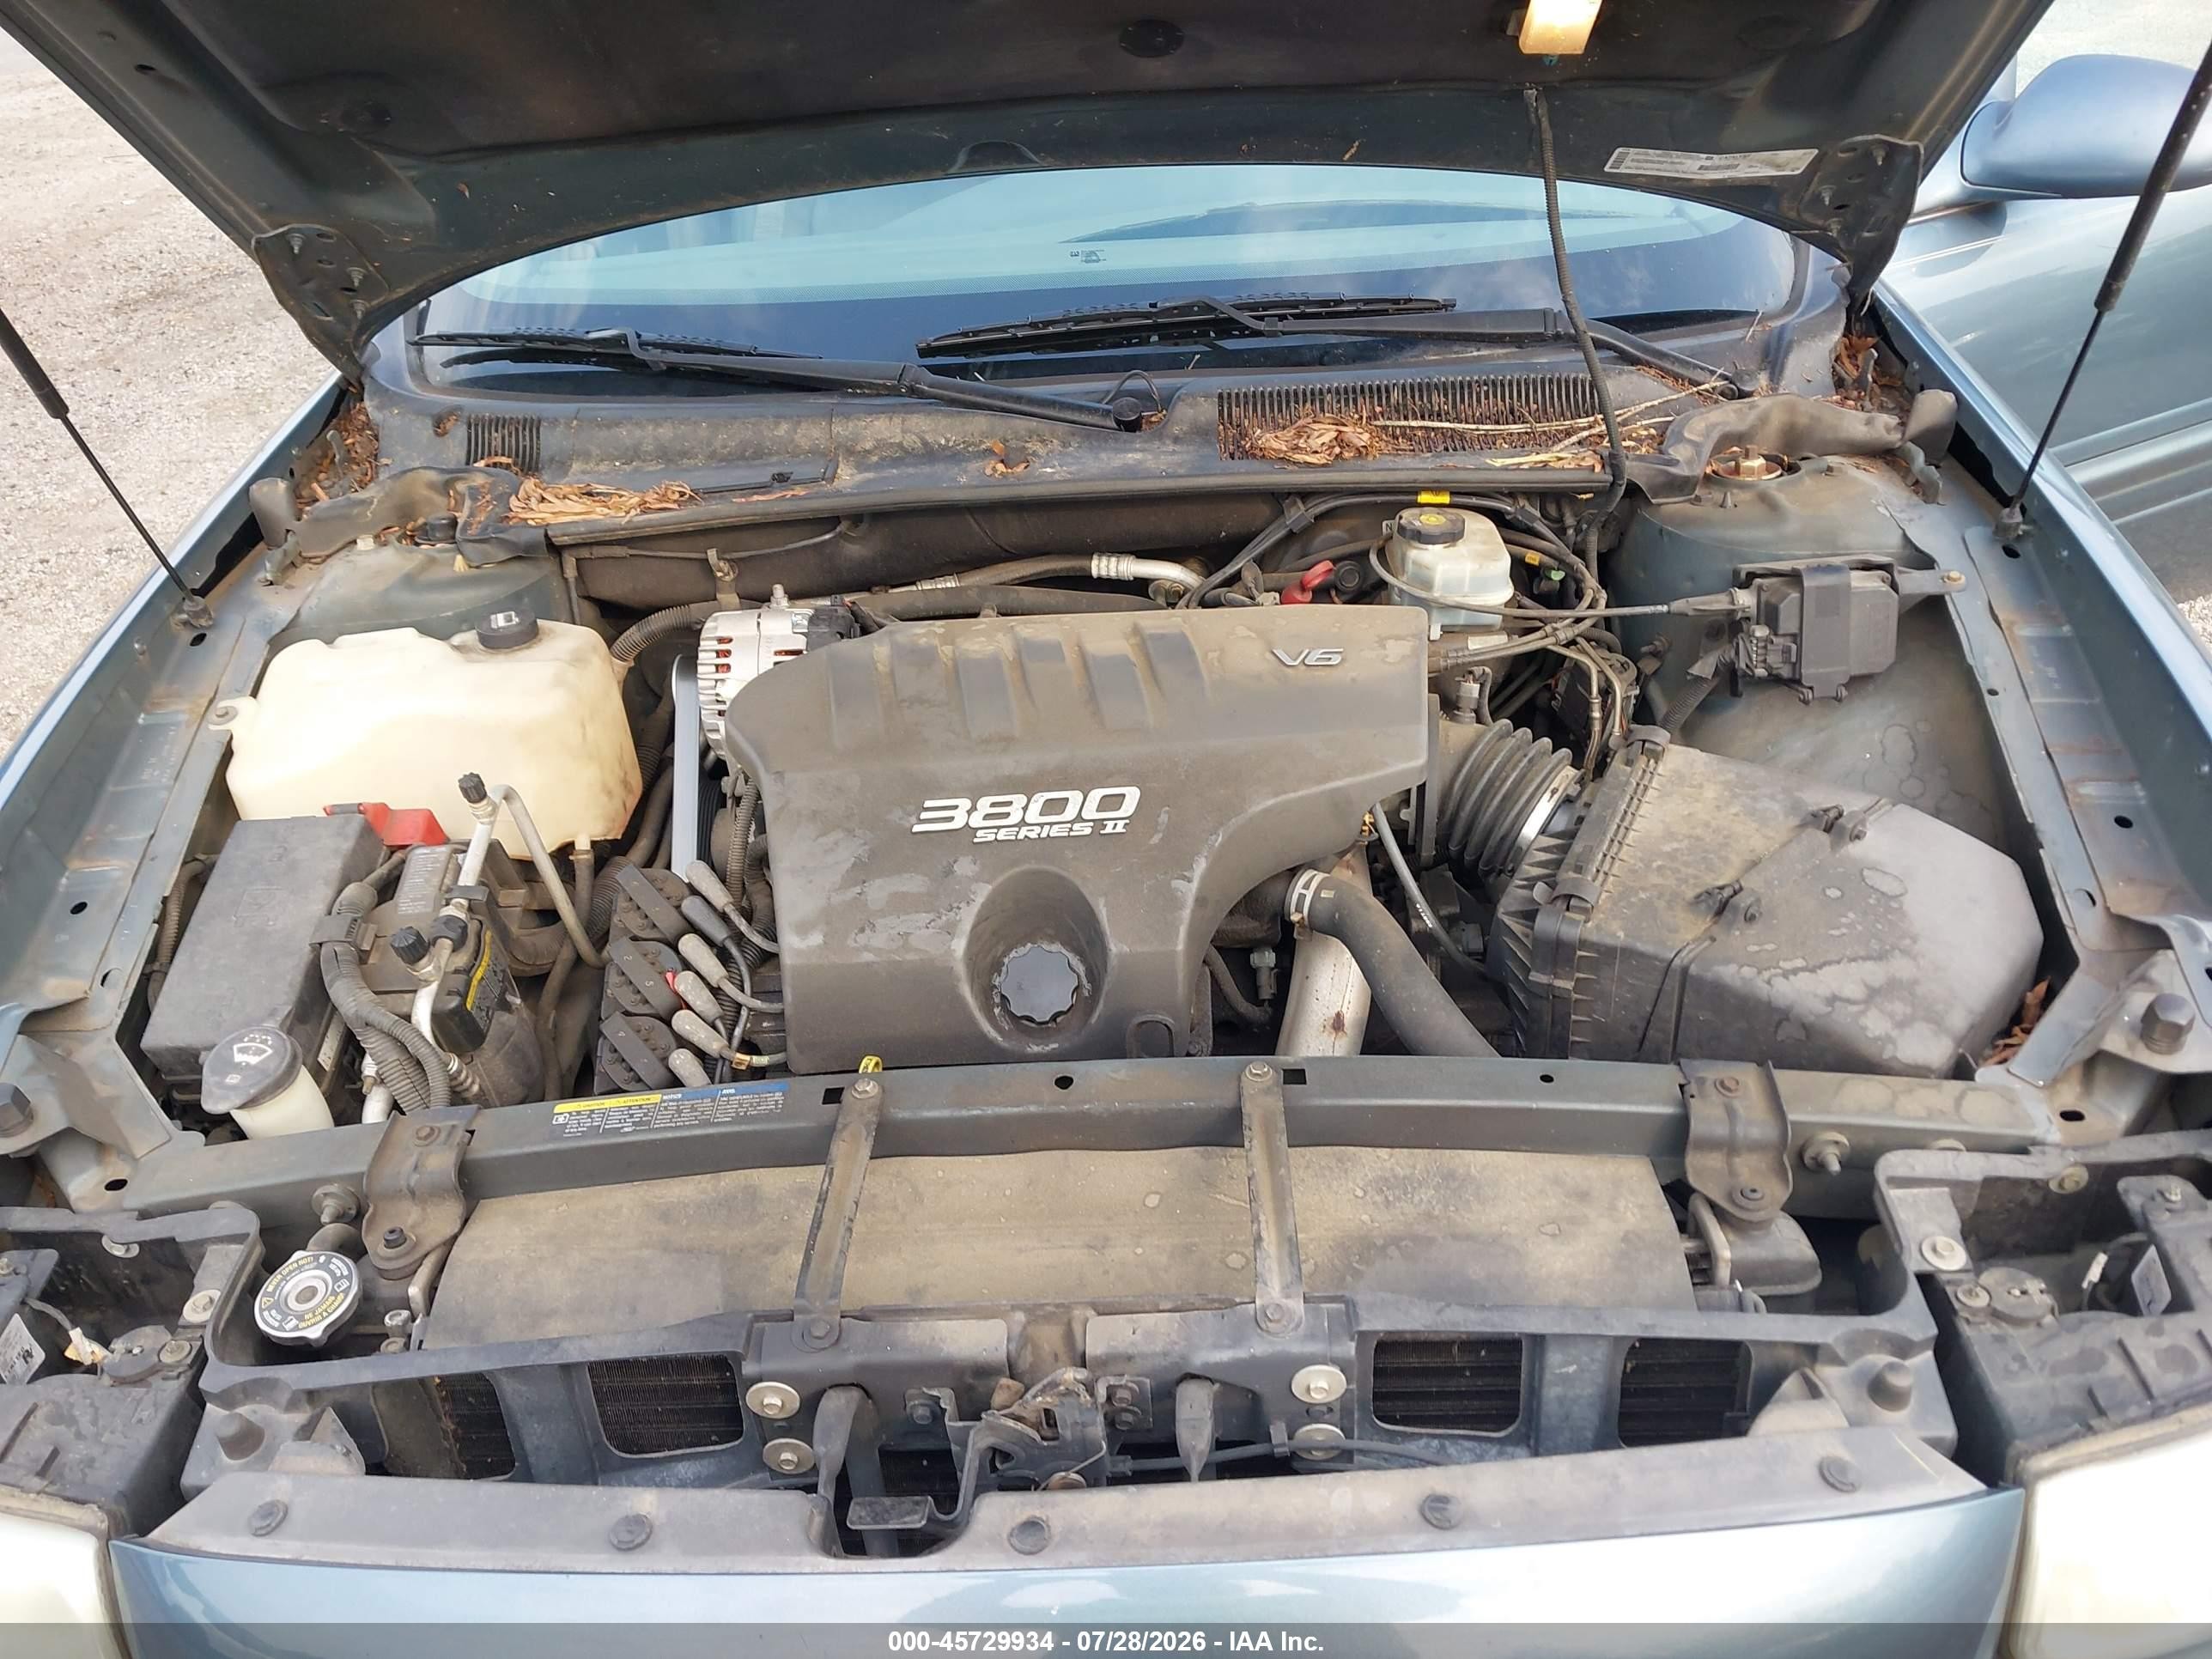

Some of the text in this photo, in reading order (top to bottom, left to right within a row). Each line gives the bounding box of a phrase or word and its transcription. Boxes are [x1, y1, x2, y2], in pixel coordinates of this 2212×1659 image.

[1272, 647, 1344, 666] V6
[911, 786, 1141, 834] 3800
[972, 819, 1130, 843] SERIES II
